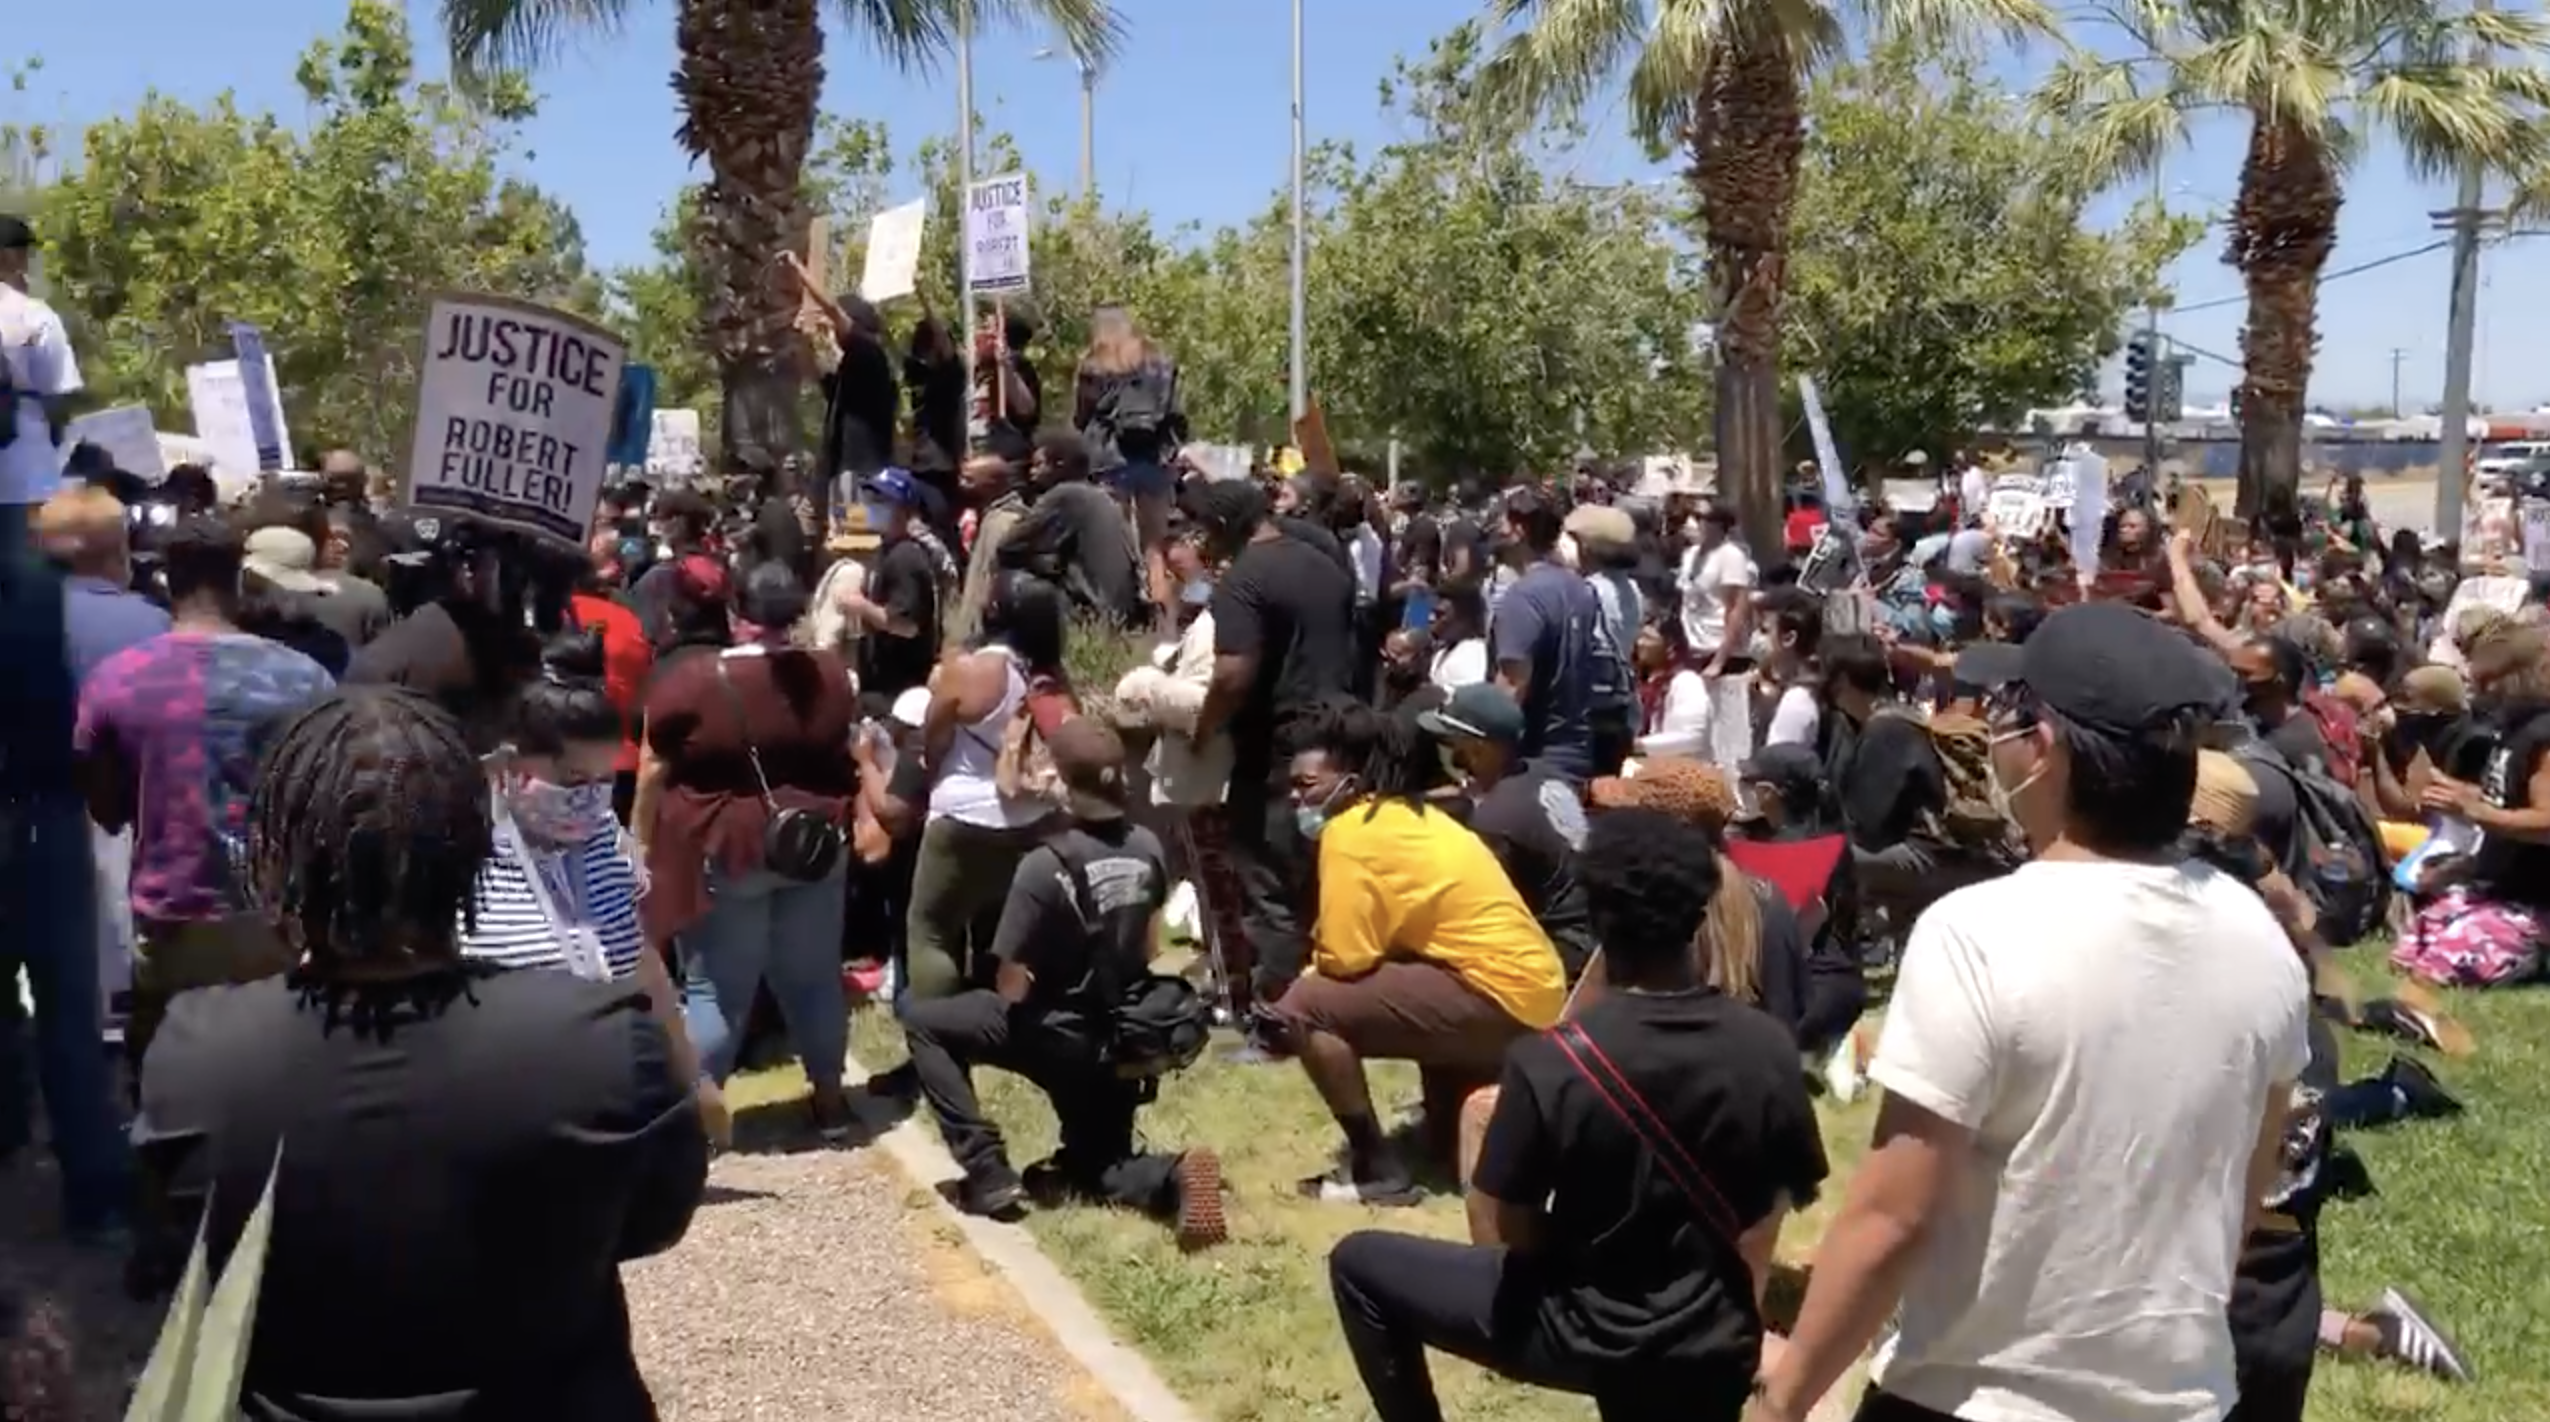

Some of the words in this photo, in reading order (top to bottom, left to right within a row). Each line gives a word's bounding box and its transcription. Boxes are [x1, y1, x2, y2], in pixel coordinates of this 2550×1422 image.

[437, 313, 610, 398] JUSTICE
[487, 372, 554, 418] FOR
[445, 416, 578, 476] ROBERT
[440, 452, 573, 513] FULLER!
